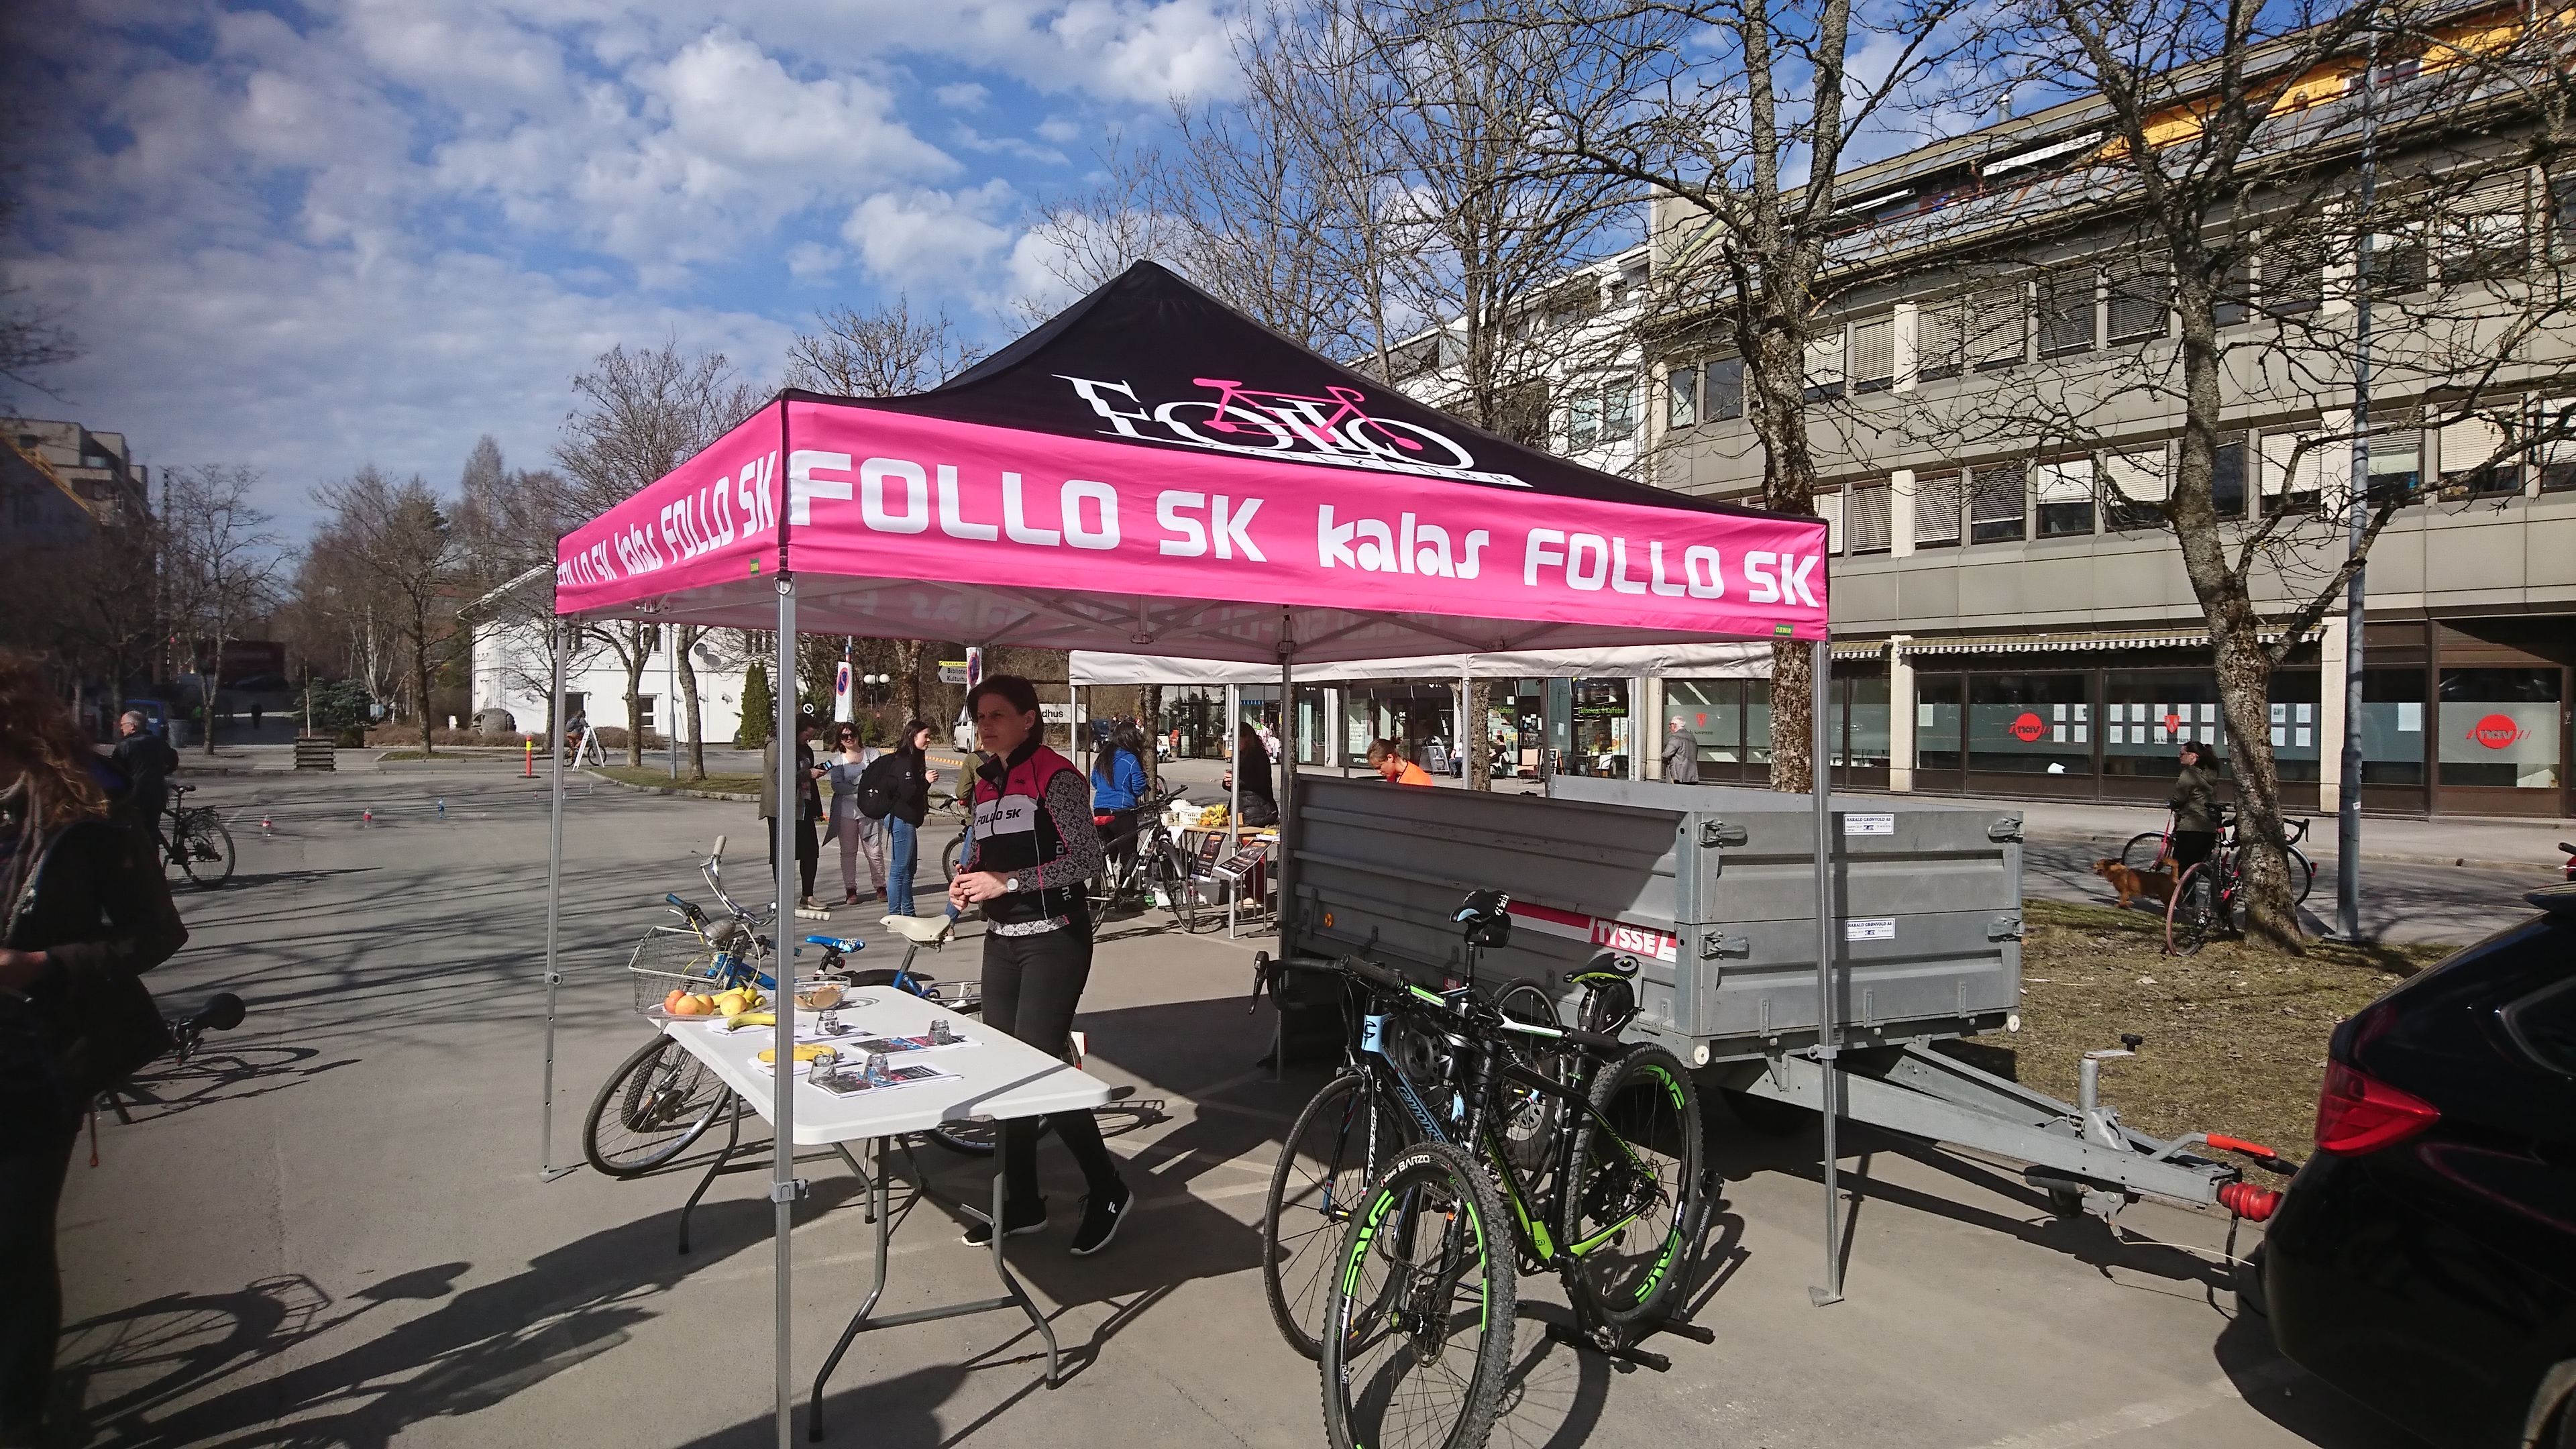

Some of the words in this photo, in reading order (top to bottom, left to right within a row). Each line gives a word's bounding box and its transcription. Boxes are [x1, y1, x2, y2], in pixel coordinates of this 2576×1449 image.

[591, 539, 617, 581] SK
[614, 523, 663, 576] kalas
[660, 476, 735, 565] FOLLO
[738, 450, 777, 539] SK
[788, 449, 1121, 550] FOLLO
[1156, 490, 1267, 562] SK
[1317, 504, 1489, 580] kalas
[1524, 527, 1725, 599] FOLLO
[1748, 550, 1821, 608] SK
[1041, 708, 1064, 718] dhus
[2479, 729, 2515, 740] nav
[1006, 808, 1022, 819] SK
[1597, 920, 1656, 955] TYSSE
[1398, 1155, 1430, 1173] BARZO
[1699, 1205, 1711, 1234] FEEDBACK
